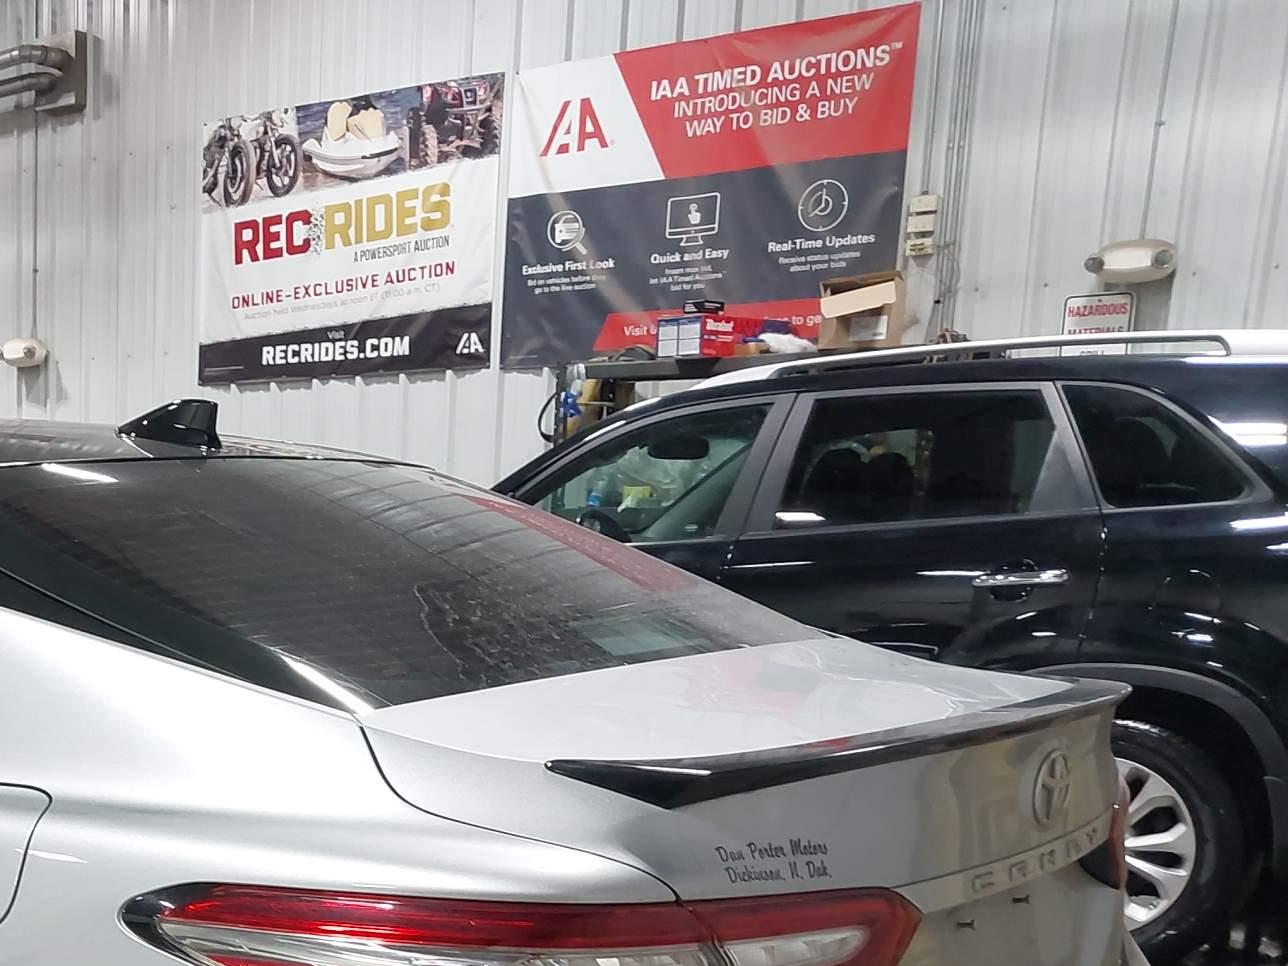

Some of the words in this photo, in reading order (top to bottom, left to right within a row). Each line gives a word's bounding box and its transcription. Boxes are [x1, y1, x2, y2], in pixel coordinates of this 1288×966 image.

[650, 78, 689, 100] IAA
[695, 66, 761, 94] TIMED
[674, 84, 800, 118] INTRODUCING
[806, 84, 820, 98] A
[827, 73, 874, 95] NEW
[686, 117, 724, 137] WAY
[730, 112, 753, 130] TO
[760, 106, 790, 126] BID
[796, 104, 810, 122] &
[817, 97, 858, 118] BUY
[234, 209, 312, 265] REC
[324, 182, 451, 250] RIDES
[353, 251, 359, 263] A
[360, 242, 412, 262] POWERSPORT
[414, 235, 450, 252] AUCTION
[650, 252, 681, 264] Quick
[683, 250, 702, 261] and
[705, 248, 730, 260] Easy
[768, 238, 822, 252] Real-Time
[826, 234, 876, 248] Updates
[522, 262, 564, 276] Exclusive
[565, 260, 586, 272] First
[589, 258, 615, 270] Look
[232, 274, 379, 310] ONLINE-EXCLUSIVE
[384, 261, 456, 285] AUCTION
[792, 316, 804, 325] to
[1068, 303, 1128, 318] HAZARDOUS
[624, 325, 648, 336] Visit
[262, 336, 410, 366] RECRIDES.COM
[715, 846, 744, 862] Dan
[790, 838, 828, 856] Motors
